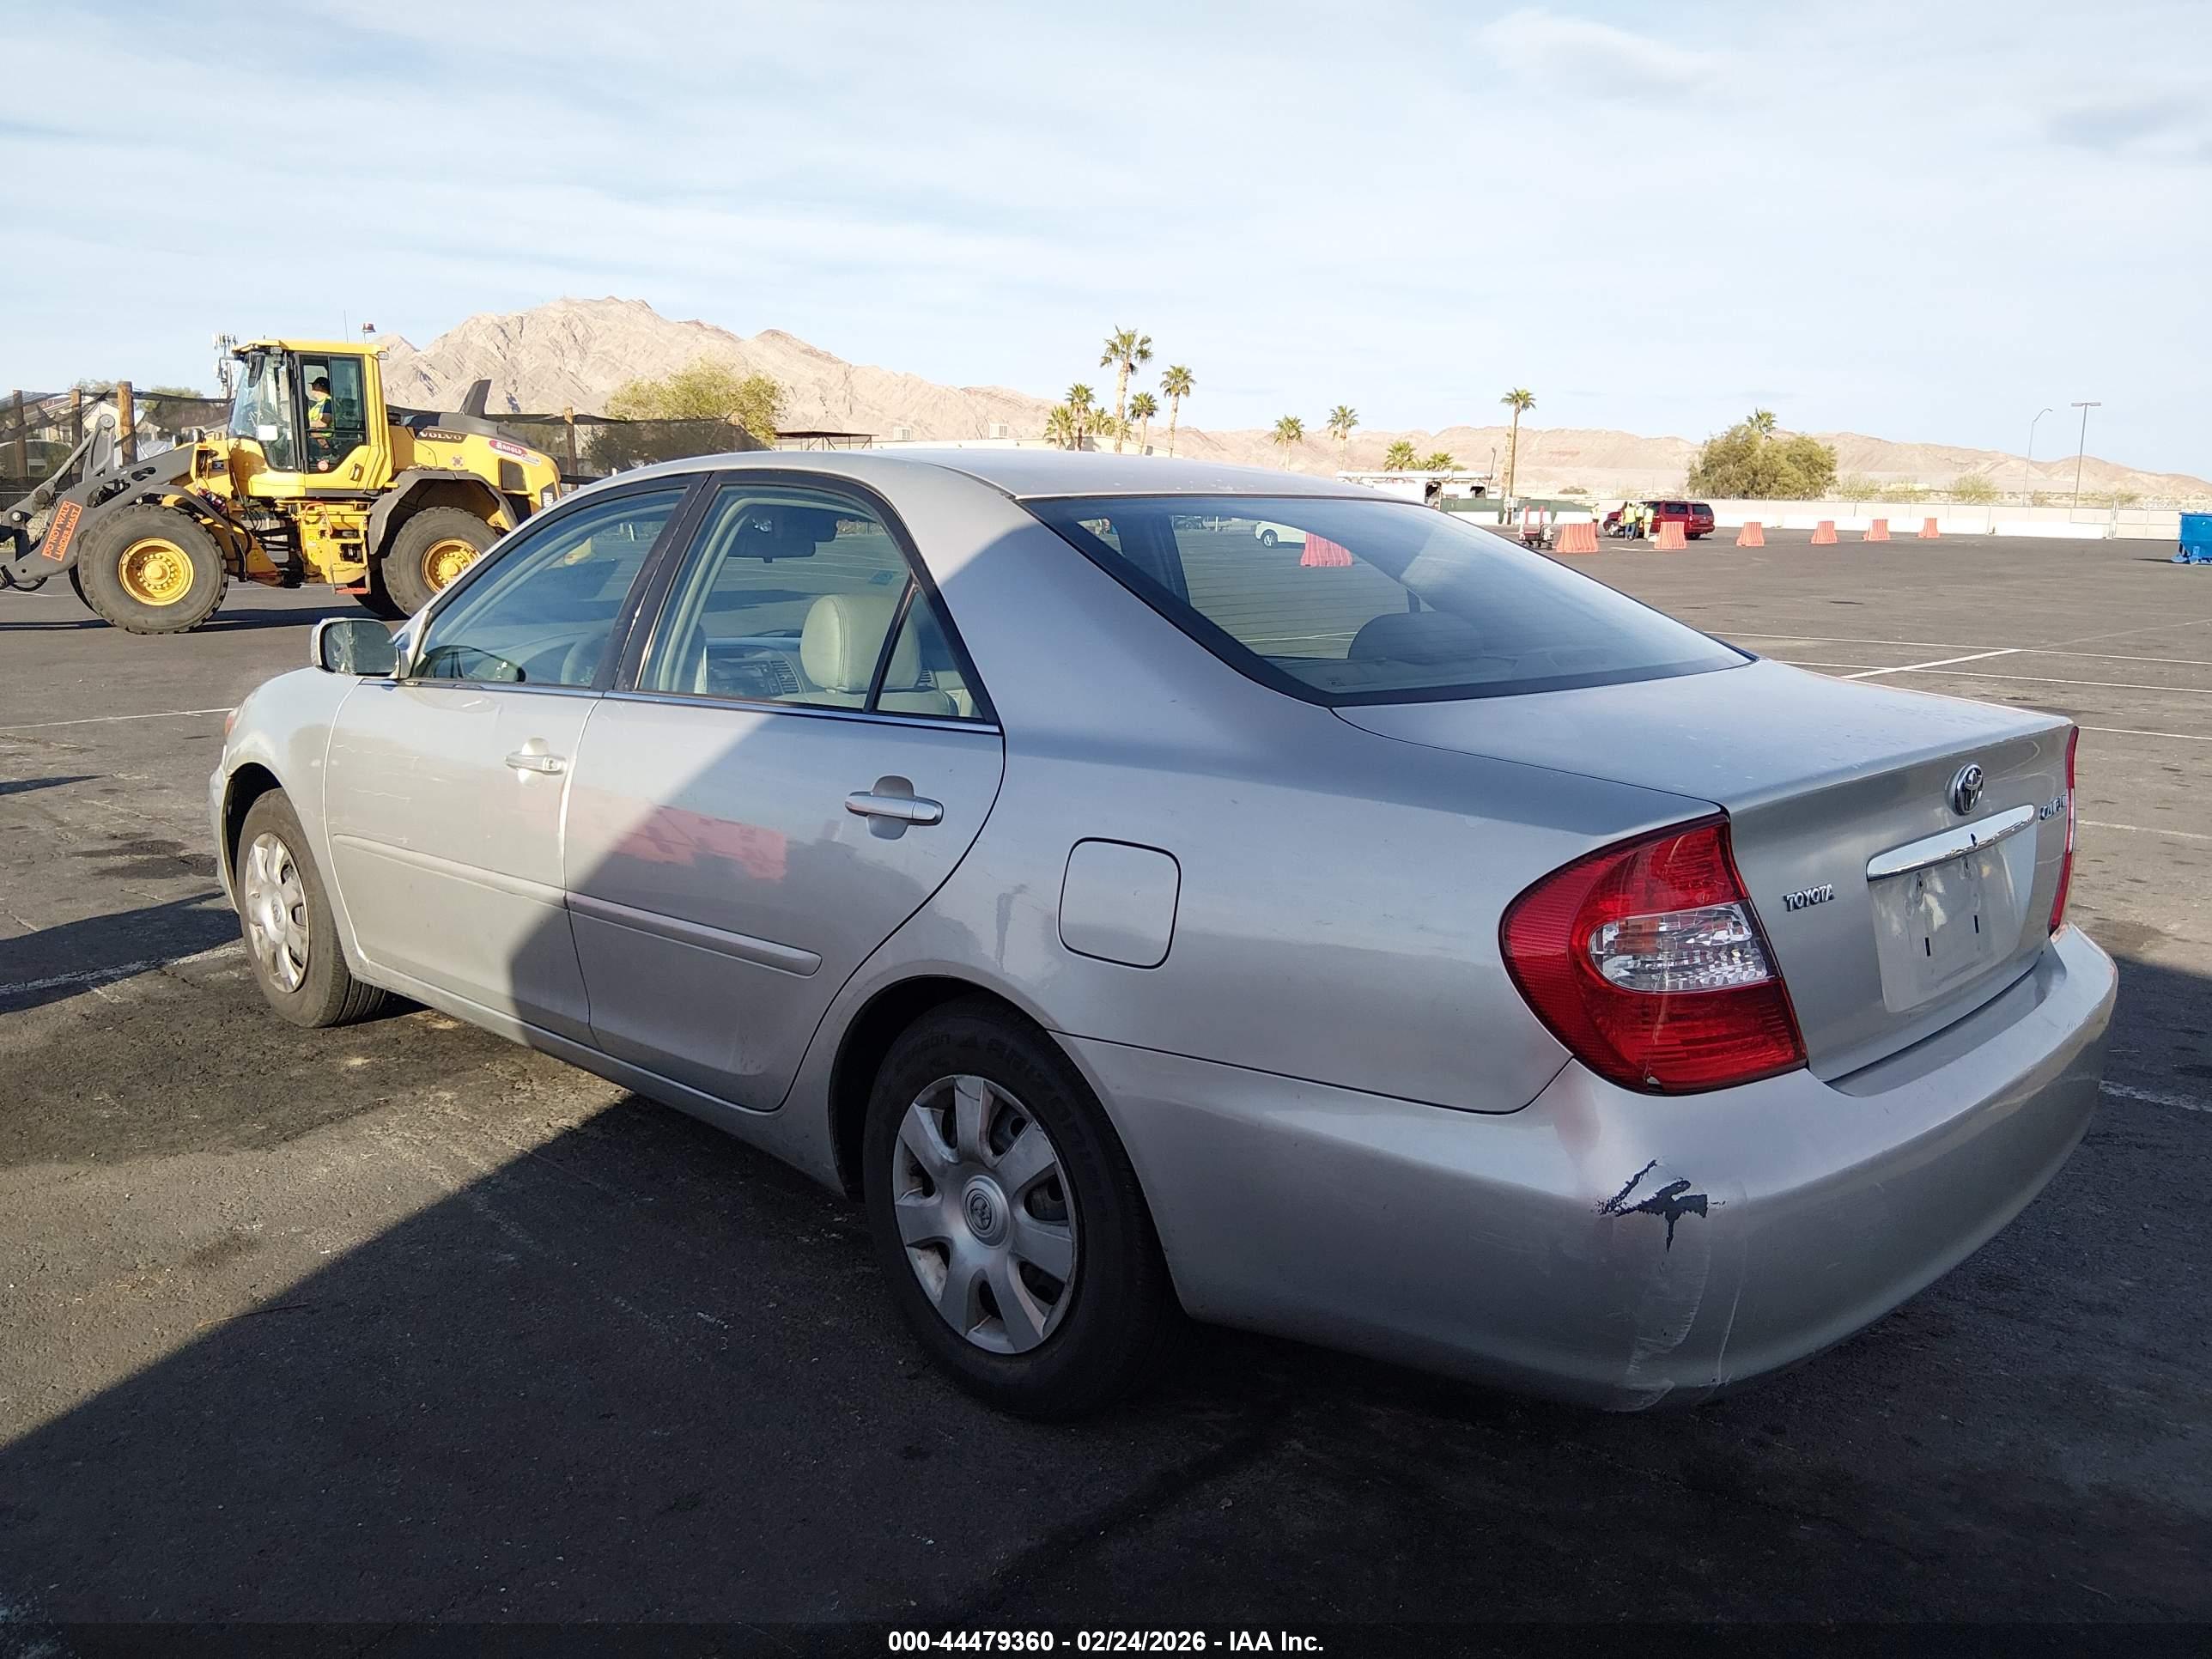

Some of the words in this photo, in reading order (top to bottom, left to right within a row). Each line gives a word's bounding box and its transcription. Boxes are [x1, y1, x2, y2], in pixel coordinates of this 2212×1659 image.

[419, 430, 462, 441] VOLVO
[46, 544, 54, 556] DO
[51, 526, 61, 544] NOT
[58, 502, 70, 525] WALK
[56, 529, 70, 555] UNDER
[66, 508, 79, 530] MAST
[1784, 884, 1834, 912] TOYOTA
